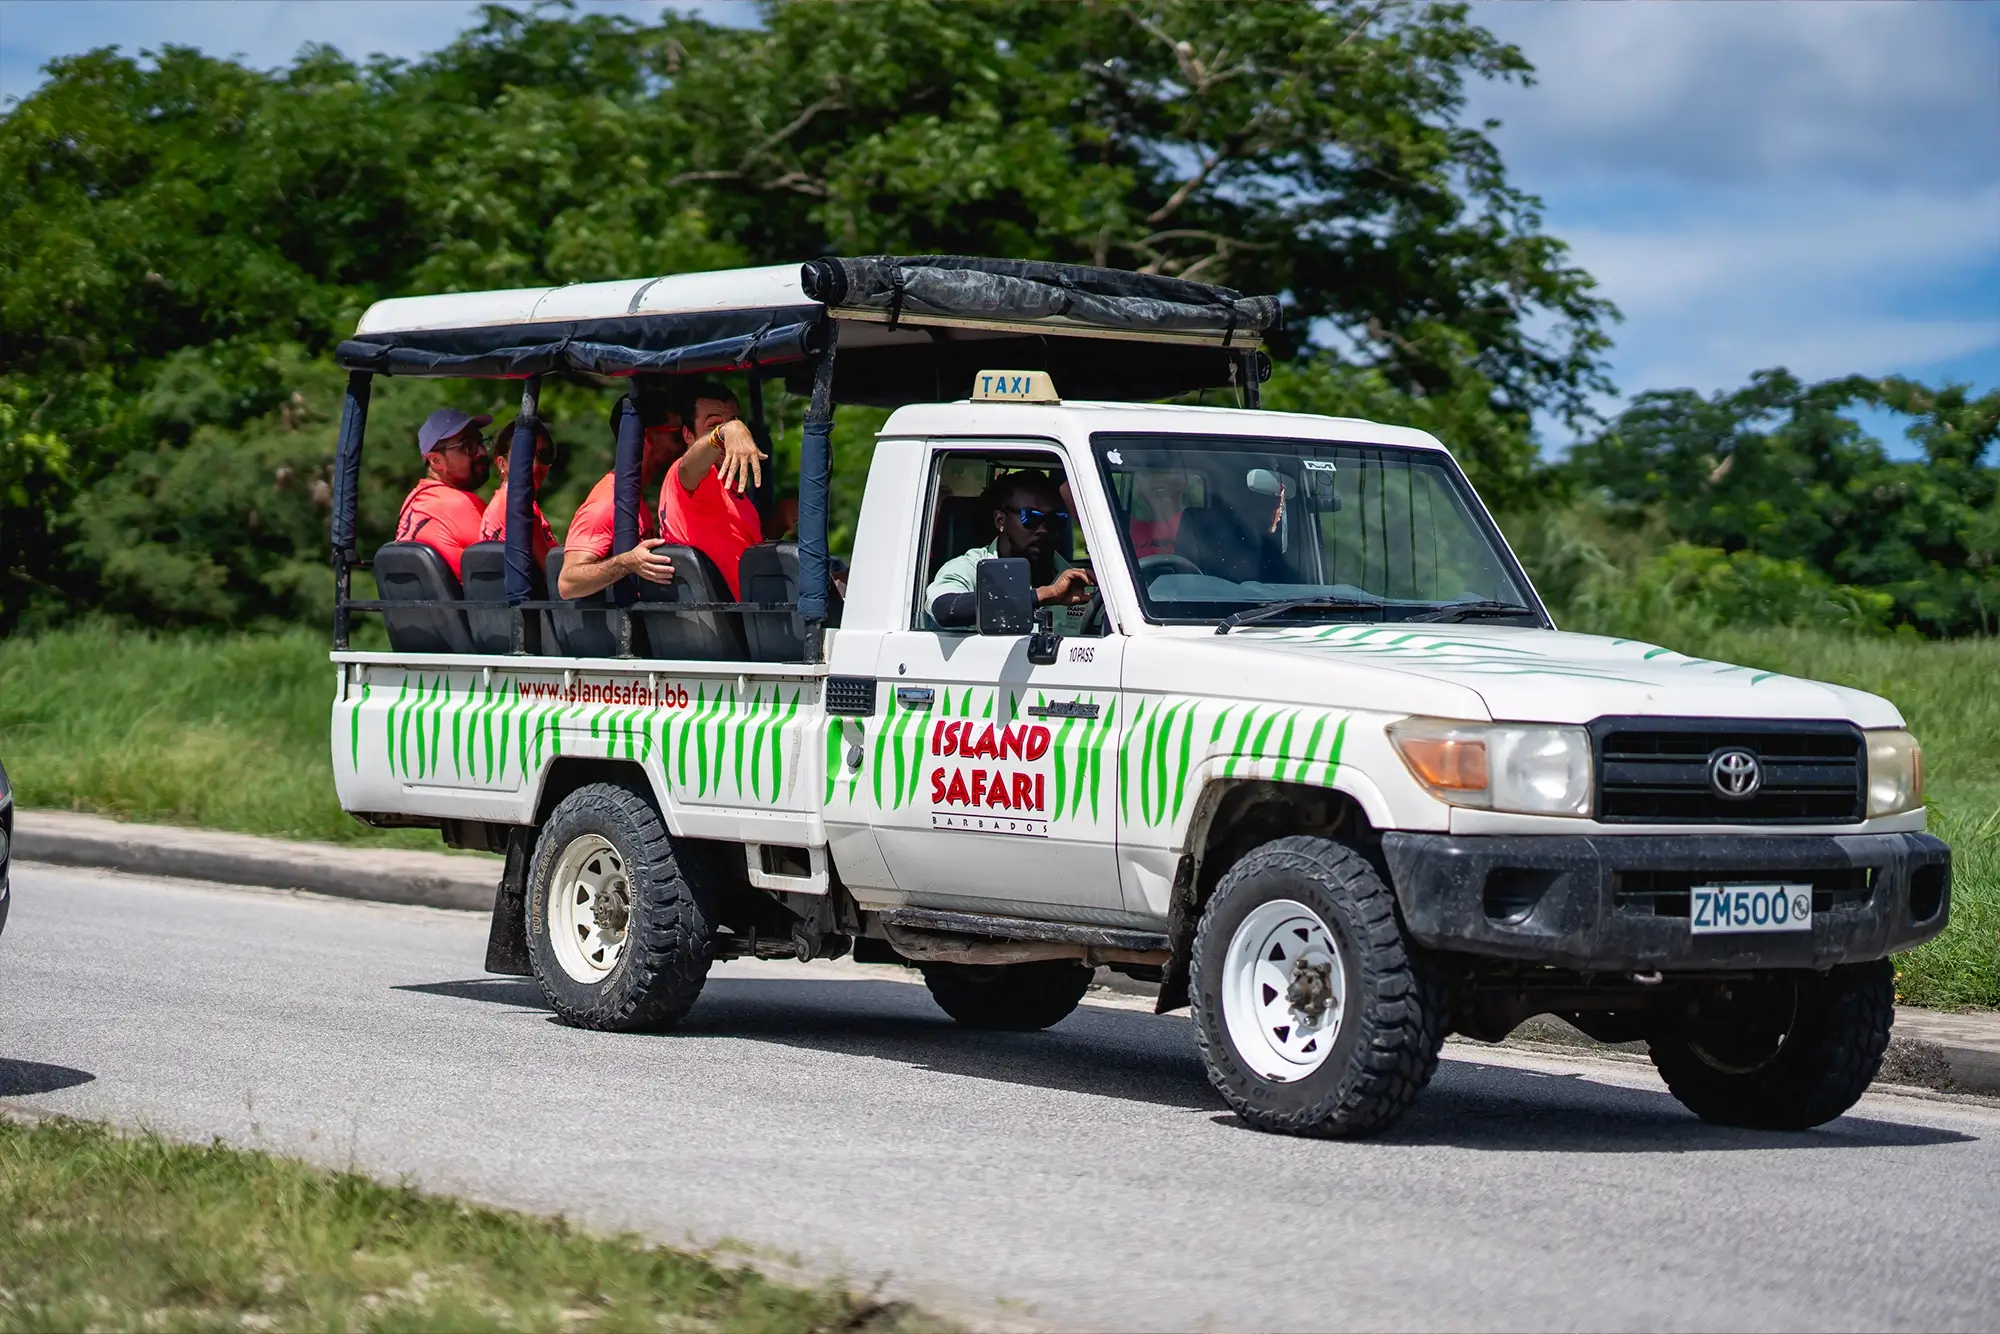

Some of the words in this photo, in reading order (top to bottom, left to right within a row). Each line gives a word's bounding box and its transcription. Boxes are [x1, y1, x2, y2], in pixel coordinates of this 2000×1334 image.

[981, 376, 1031, 394] TAXI
[519, 678, 689, 709] www.islandsafari.bb
[931, 720, 1051, 762] ISLAND
[931, 766, 1045, 812] SAFARI
[932, 816, 1048, 833] BARBADOS
[1694, 892, 1789, 927] ZM500
